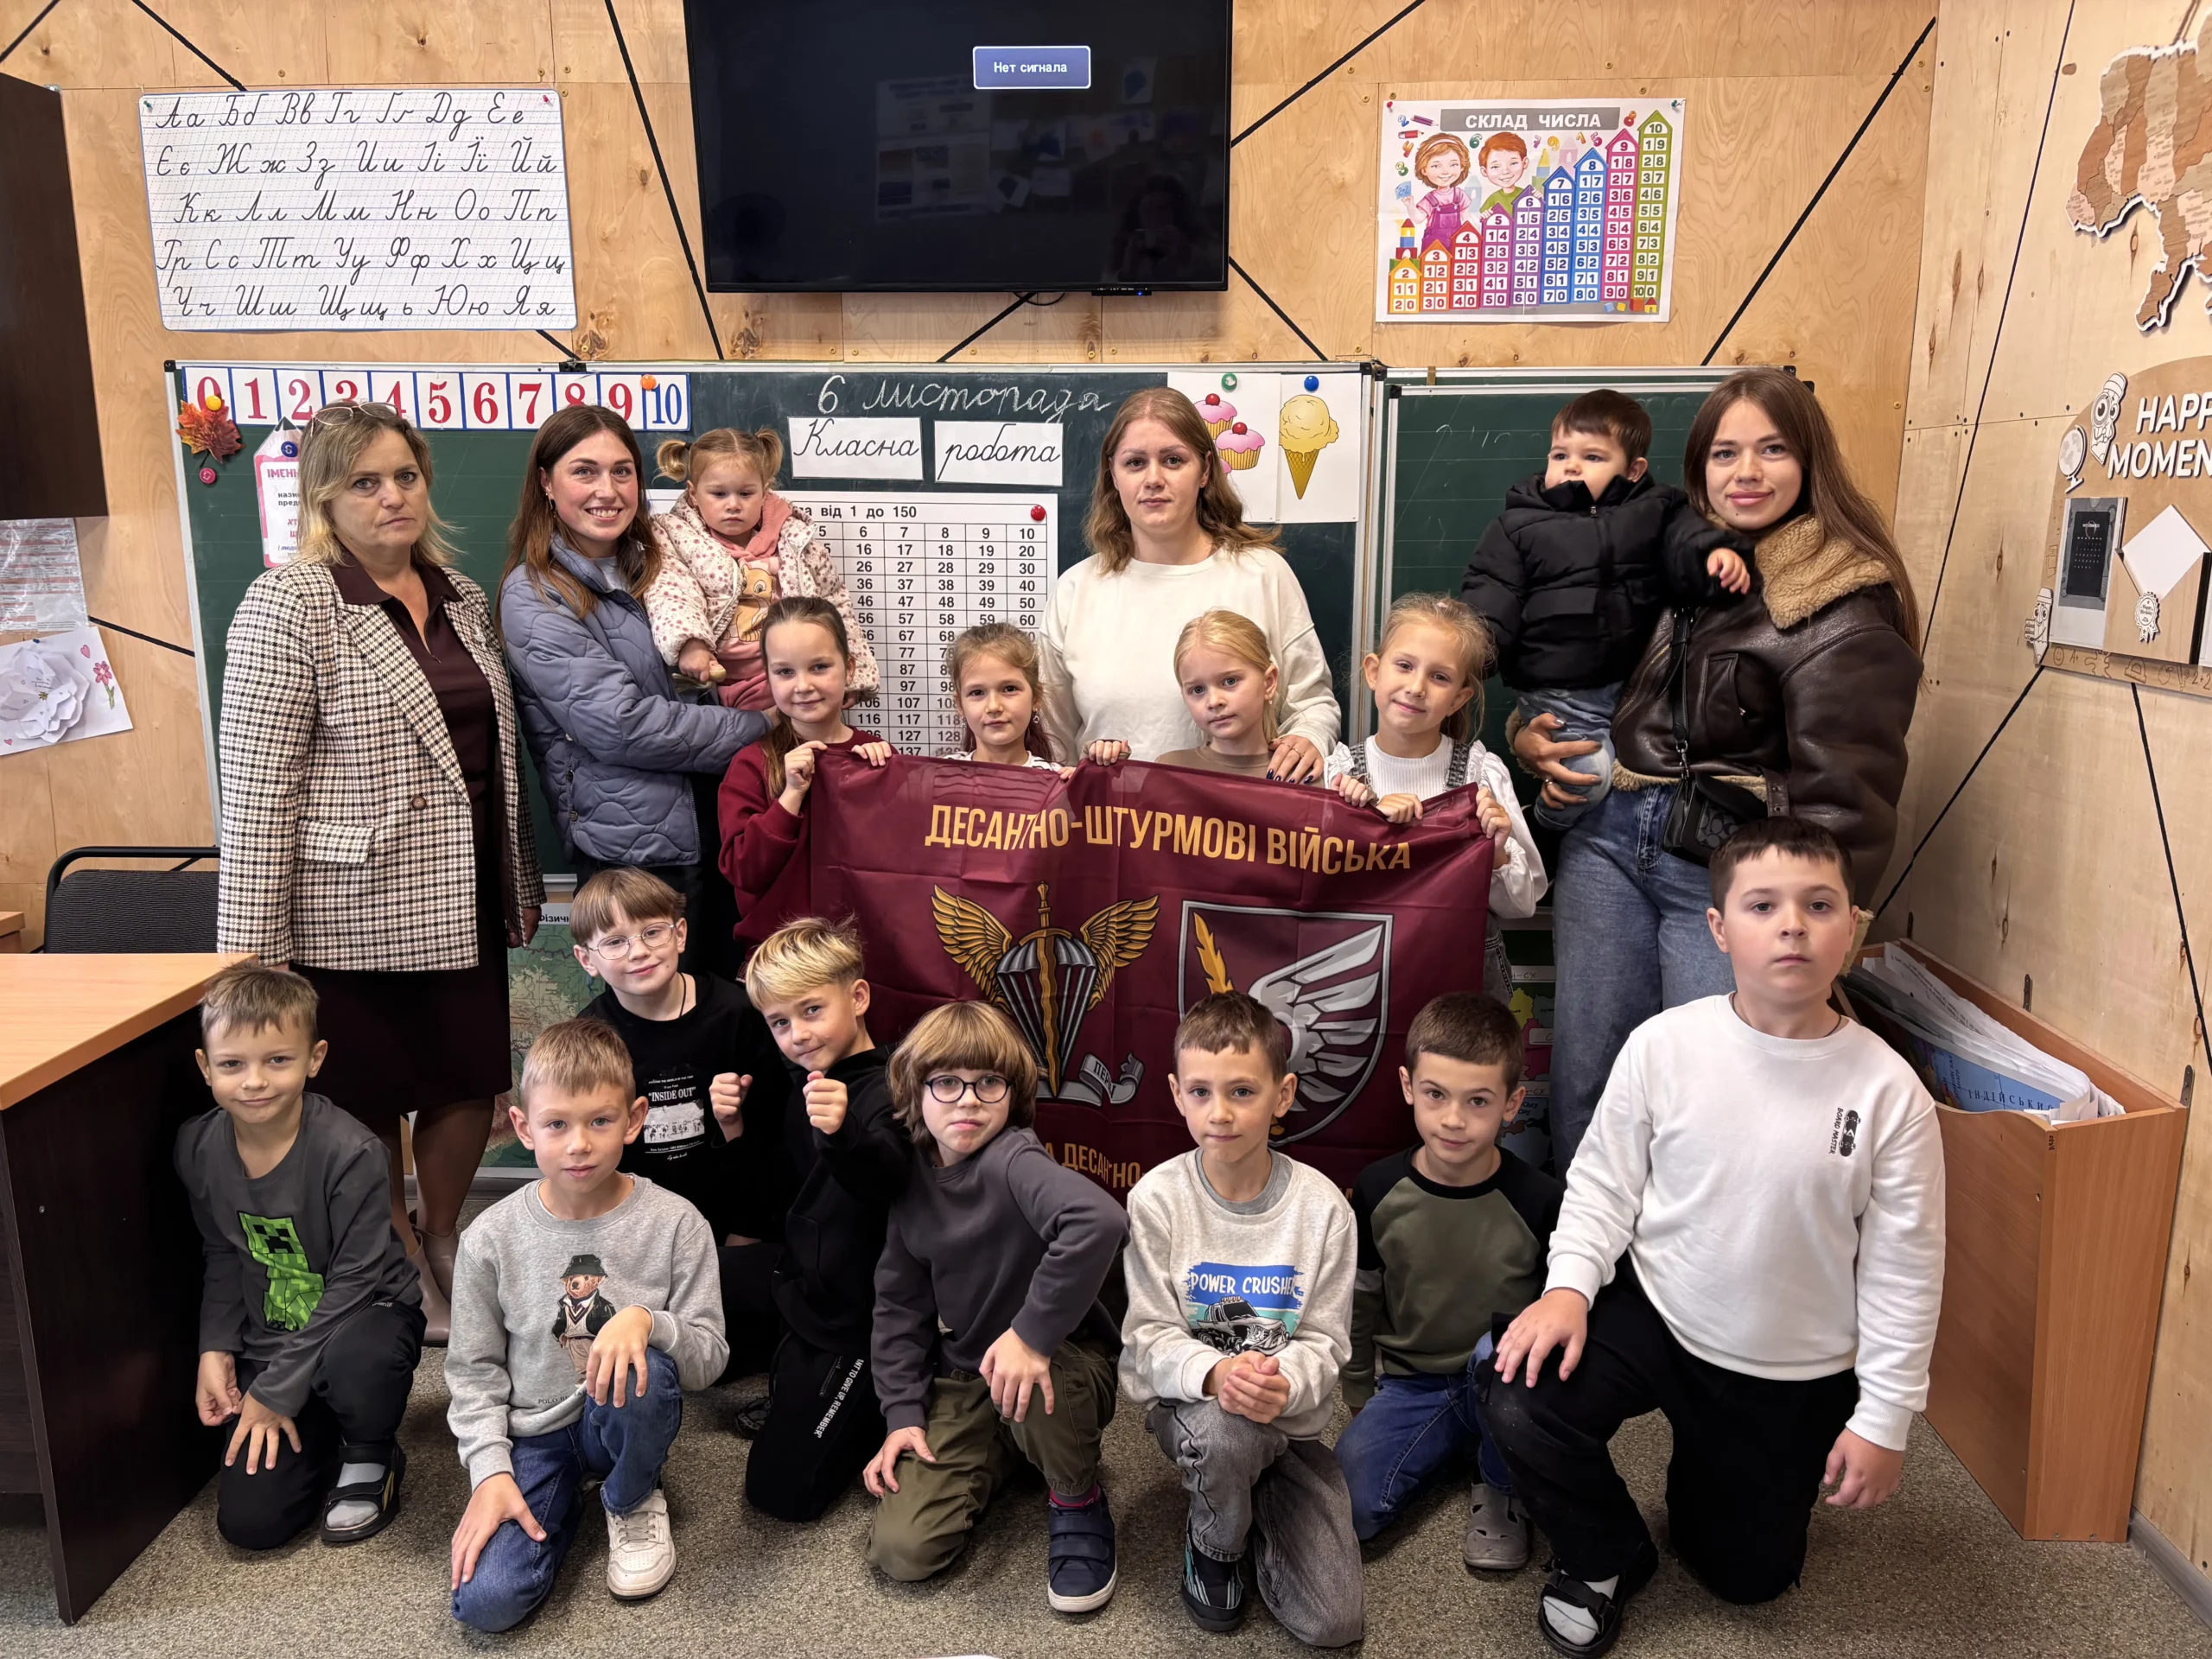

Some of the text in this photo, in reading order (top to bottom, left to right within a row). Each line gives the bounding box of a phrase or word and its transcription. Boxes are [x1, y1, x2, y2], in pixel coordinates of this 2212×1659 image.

[993, 61, 1068, 73] Нет сигнала
[1465, 113, 1601, 130] СКЛАД ЧИСЛА
[1649, 124, 1662, 133] 10
[1620, 142, 1628, 151] 9
[1588, 162, 1596, 170] 8
[1557, 179, 1565, 188] 7
[1526, 198, 1534, 207] 6
[1495, 216, 1502, 225] 5
[1463, 233, 1471, 242] 4
[1433, 251, 1440, 260] 3
[1402, 270, 1409, 278] 2
[245, 378, 267, 419] 1
[289, 379, 313, 421] 2
[429, 381, 452, 423] 5
[473, 382, 499, 423] 6
[518, 383, 542, 424] 7
[608, 383, 632, 423] 9
[652, 383, 682, 425] 10
[817, 375, 1112, 424] 6 листопада
[793, 418, 1061, 480] Класна робота
[821, 506, 842, 518] від
[850, 506, 855, 517] 1
[866, 508, 884, 518] до
[893, 506, 917, 518] 150
[819, 526, 1035, 539] 5 6 7 8 9 10
[856, 543, 1036, 556] 16 17 18 19 20
[856, 561, 1036, 574] 26 27 28 29 30
[857, 578, 1036, 591] 36 37 38 39 40
[857, 595, 1036, 608] 46 47 48 49 50
[858, 613, 1036, 626] 56 57 58 59 60
[899, 630, 915, 641] 67
[939, 631, 955, 642] 68
[899, 647, 915, 658] 77
[899, 664, 916, 675] 87
[899, 681, 916, 692] 97
[897, 697, 920, 709] 107
[857, 714, 961, 725] 116 117 118
[898, 730, 961, 742] 127 128
[925, 804, 1411, 875] ДЕСАНТНО-ШТУРМОВІ ВІЙСЬКА
[1190, 1273, 1236, 1294] POWER
[849, 1369, 859, 1379] TO
[841, 1376, 854, 1393] GIVE
